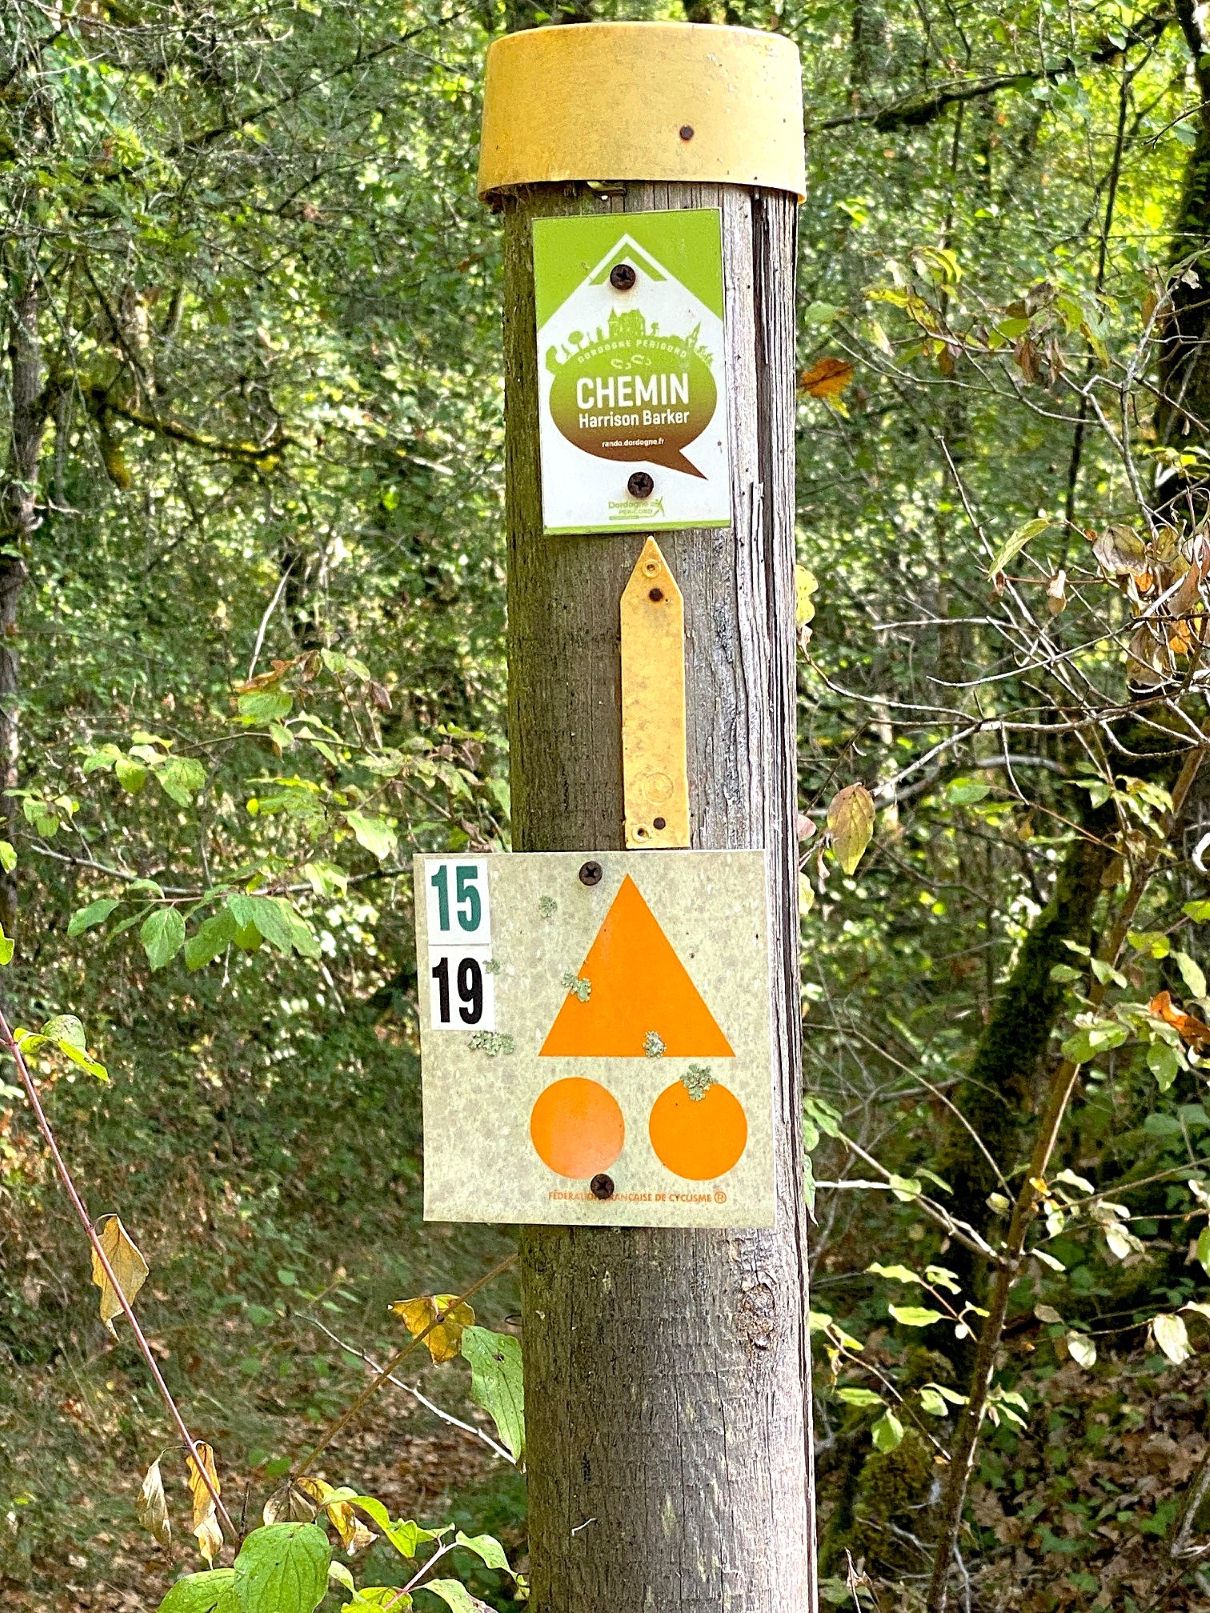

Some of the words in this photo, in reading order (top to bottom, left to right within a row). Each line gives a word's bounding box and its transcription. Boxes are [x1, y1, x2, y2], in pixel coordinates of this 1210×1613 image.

[576, 373, 690, 410] CHEMIN
[578, 411, 640, 429] Harrison
[642, 408, 690, 426] Barker
[601, 437, 665, 448] rando.dordogne.fr
[431, 865, 482, 932] 15
[432, 957, 484, 1025] 19
[655, 1193, 667, 1202] DE
[669, 1194, 712, 1203] CYCLISME
